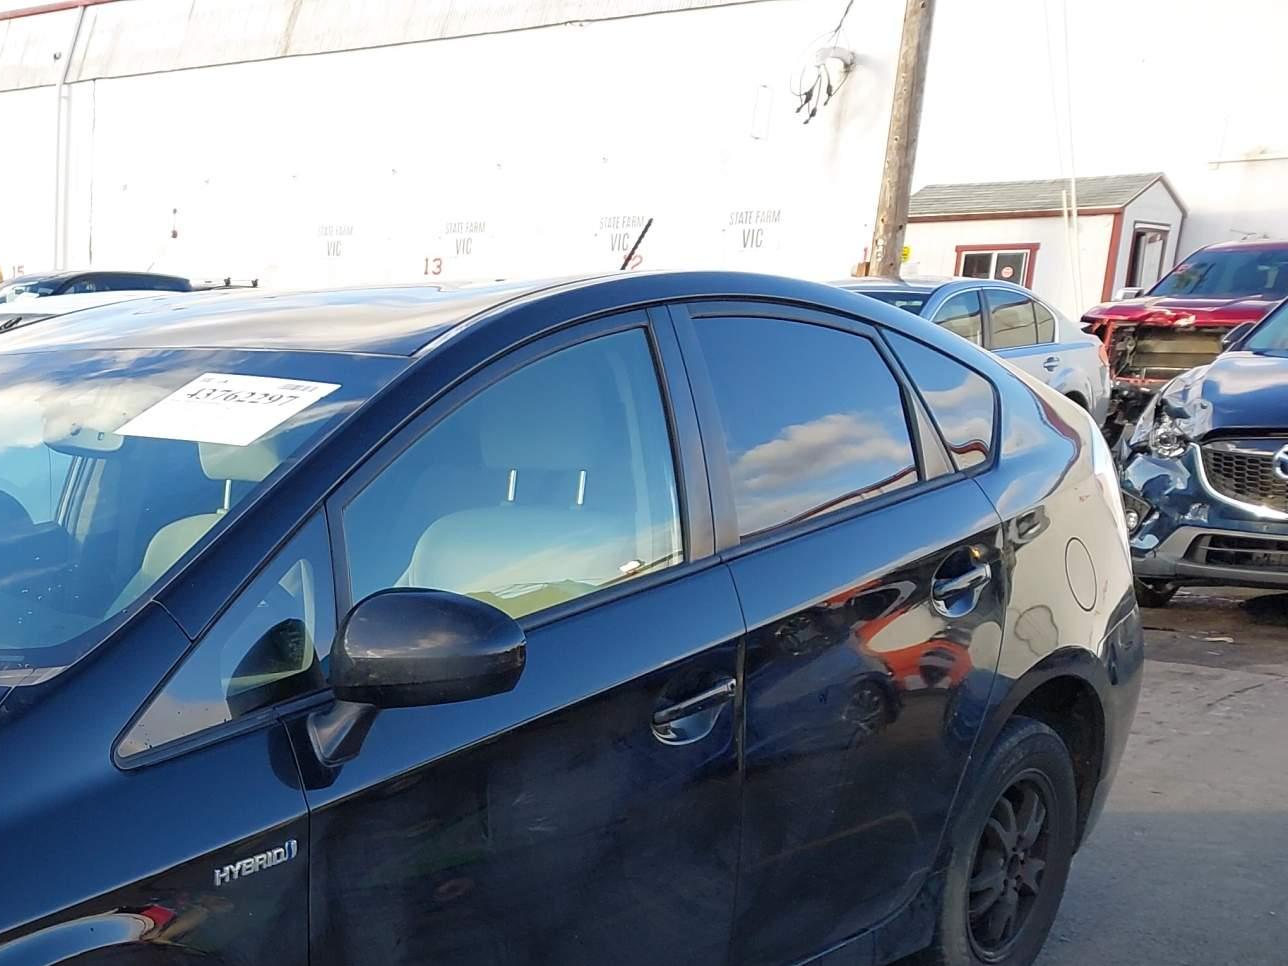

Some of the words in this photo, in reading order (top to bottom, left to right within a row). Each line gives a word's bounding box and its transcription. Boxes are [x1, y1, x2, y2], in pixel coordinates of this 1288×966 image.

[600, 216, 620, 229] STATE
[622, 216, 644, 228] FARM
[729, 211, 753, 225] STATE
[755, 209, 781, 224] FARM
[445, 222, 463, 234] STATE
[465, 221, 486, 233] FARM
[456, 238, 472, 255] VIC
[611, 232, 629, 252] VIC
[742, 228, 764, 248] VIC
[327, 240, 341, 256] VIC
[423, 257, 442, 275] 13
[187, 387, 300, 406] 43762297
[214, 847, 287, 887] HYBRID
